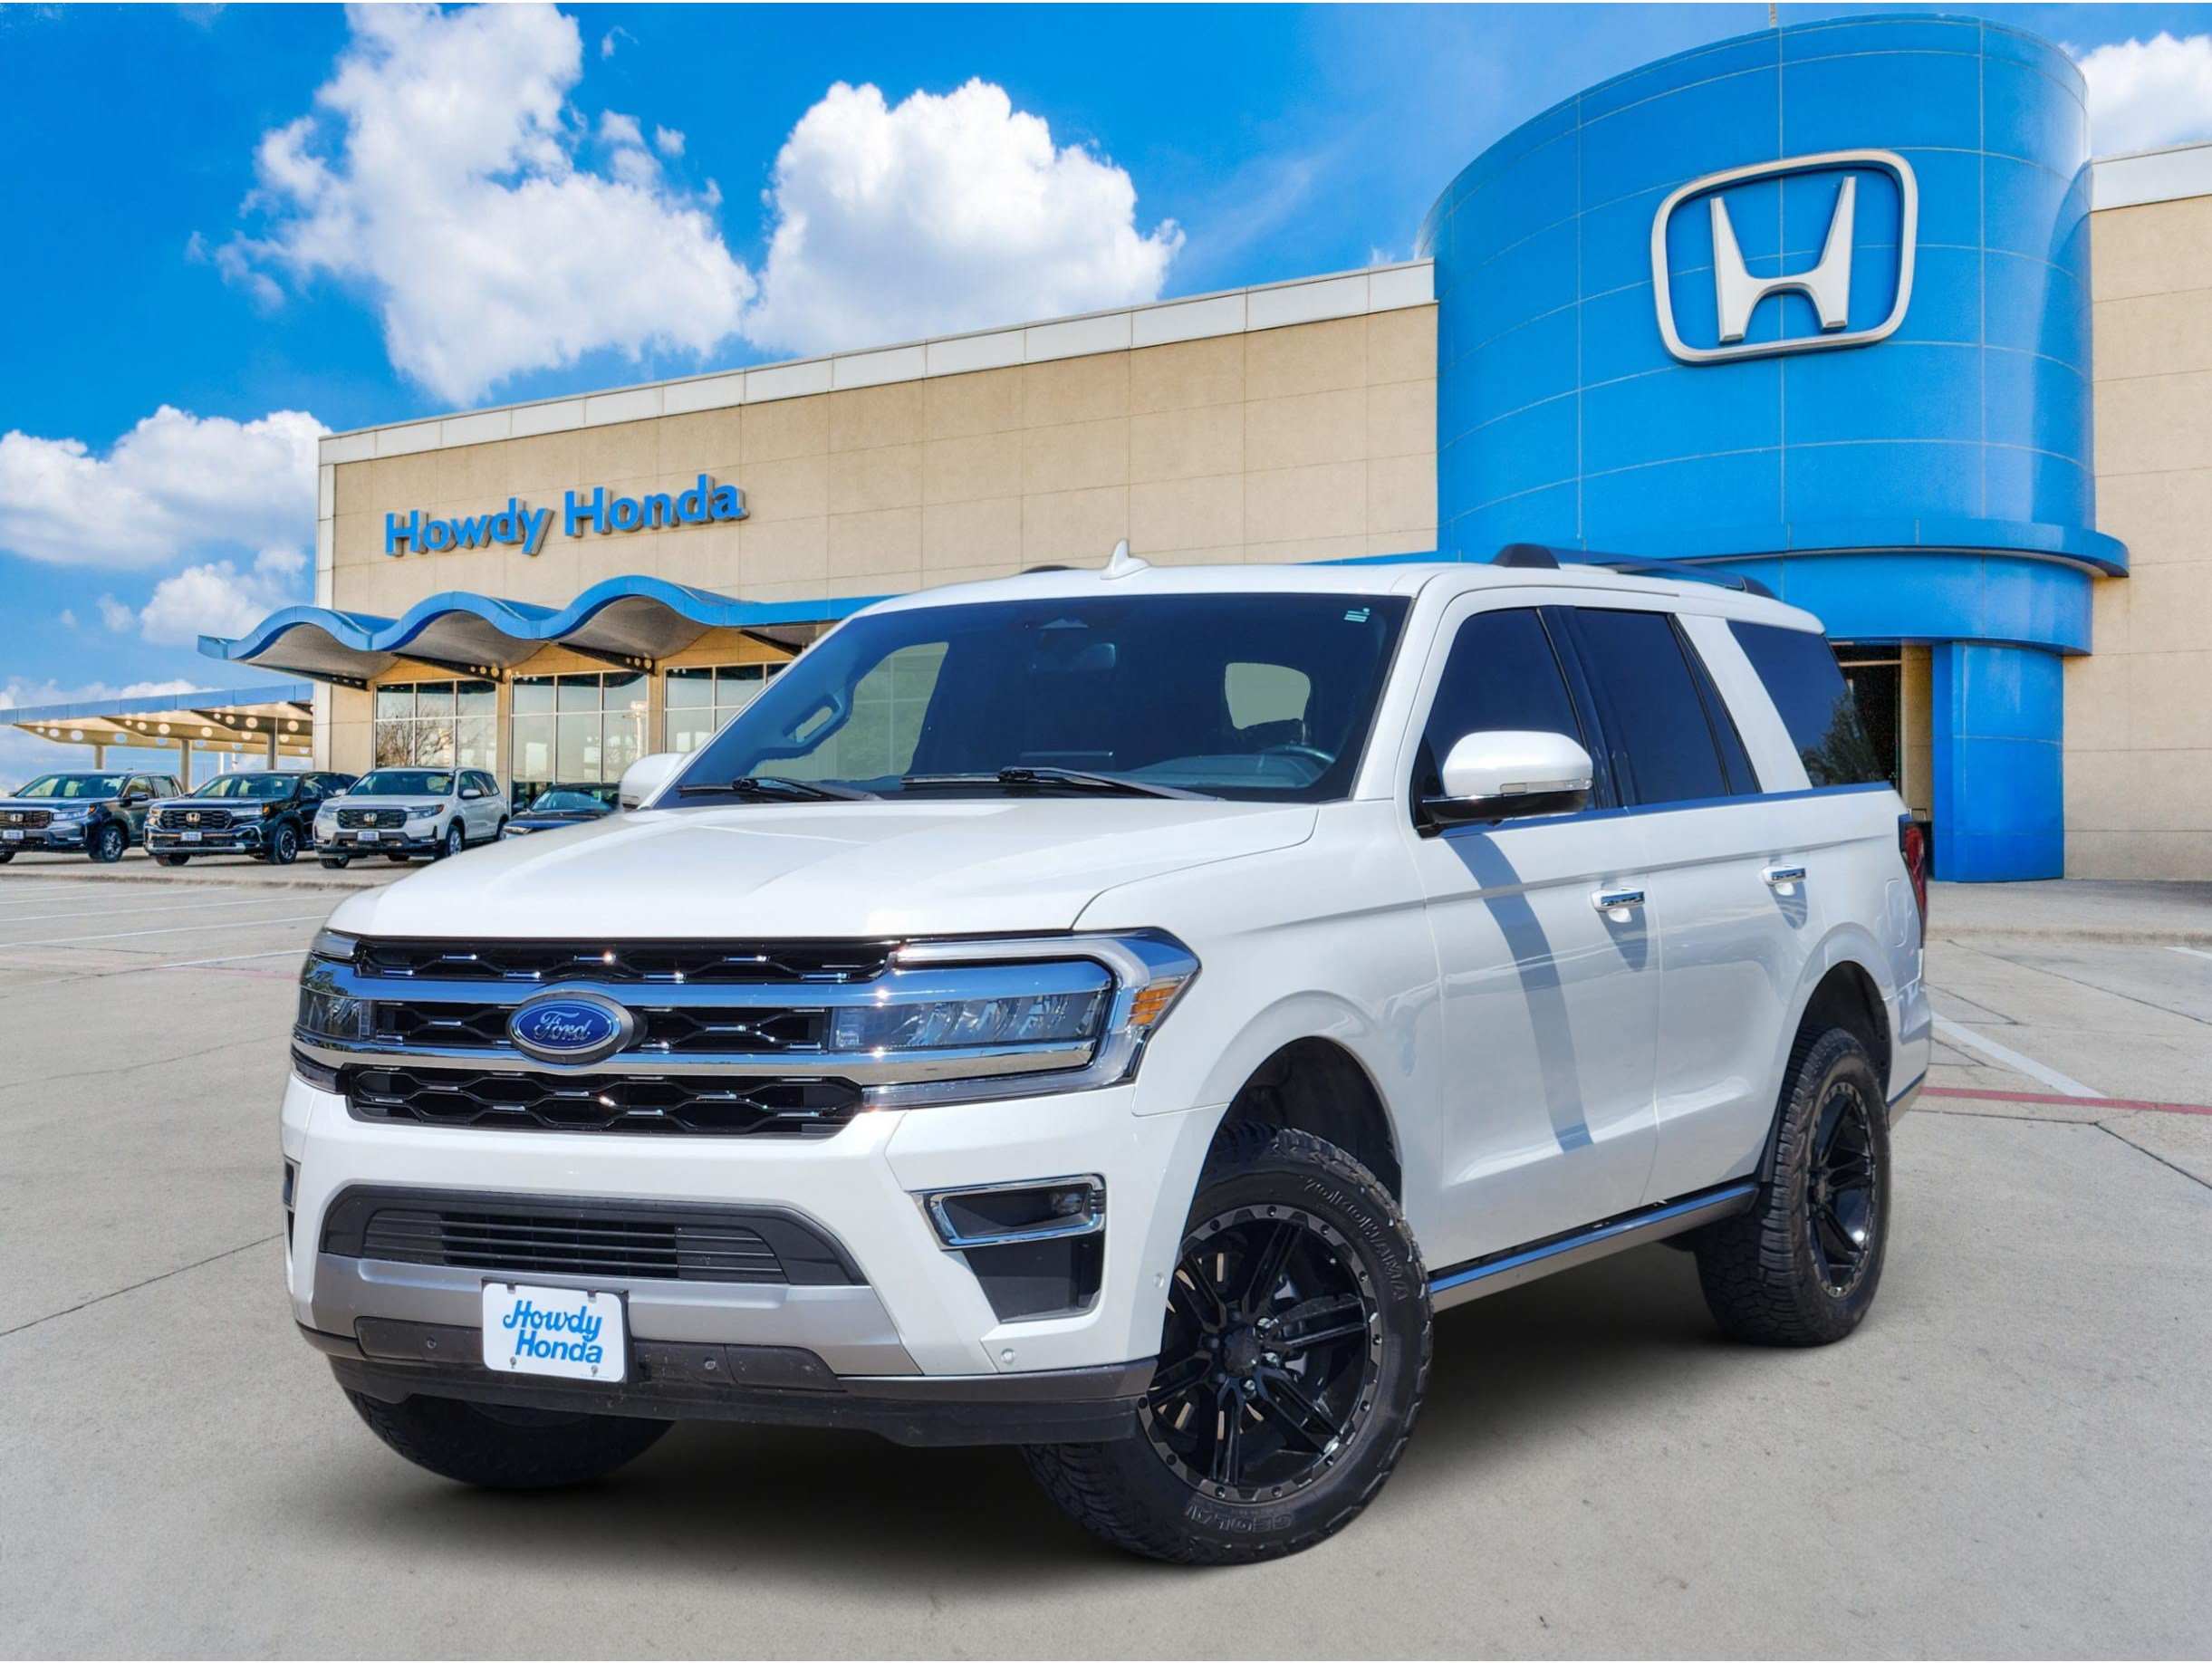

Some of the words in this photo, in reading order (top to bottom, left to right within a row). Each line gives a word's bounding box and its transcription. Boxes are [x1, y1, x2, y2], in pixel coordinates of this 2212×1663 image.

[384, 495, 554, 557] Howdy
[563, 473, 749, 538] Honda
[534, 1010, 591, 1040] Ford
[503, 1299, 602, 1342] Howdy
[515, 1329, 603, 1364] Honda
